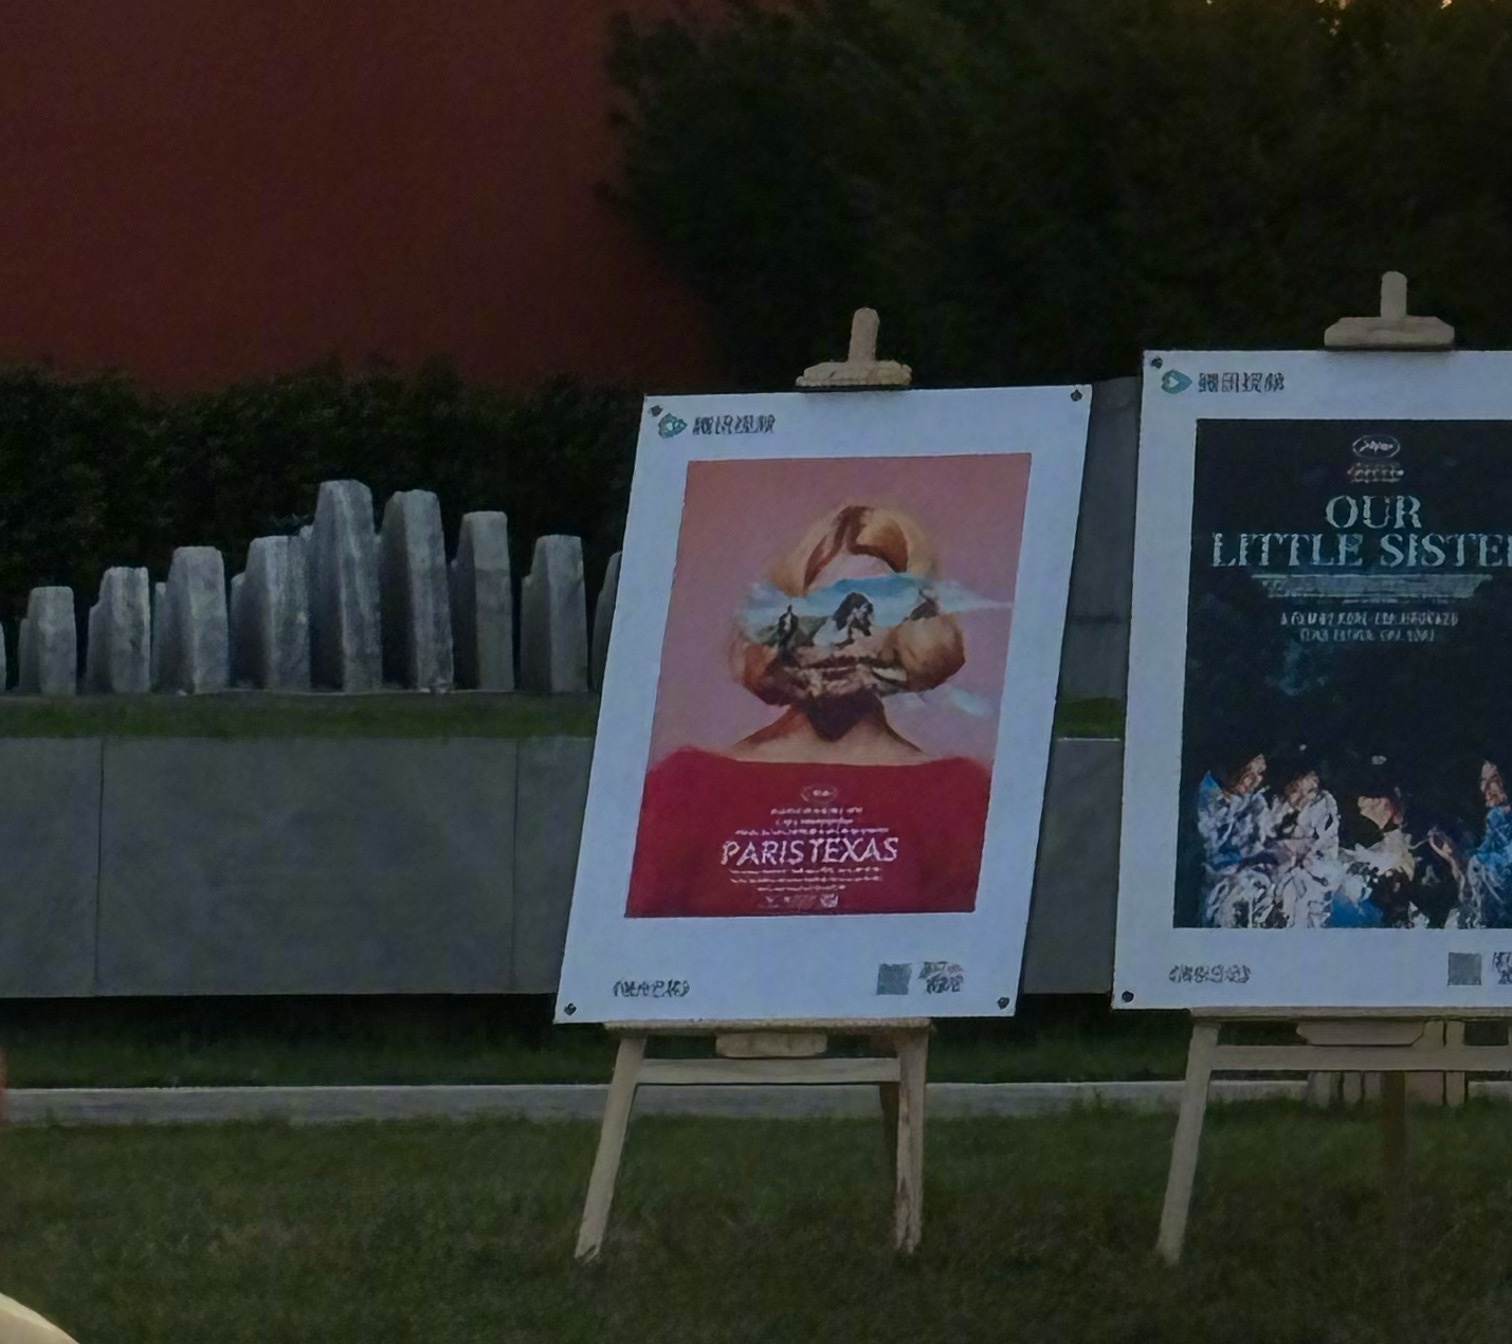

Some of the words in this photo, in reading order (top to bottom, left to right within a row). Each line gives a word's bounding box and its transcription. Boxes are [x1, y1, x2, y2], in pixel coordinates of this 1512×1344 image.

[1325, 495, 1423, 529] OUR
[1212, 532, 1364, 568] LITTLE
[719, 839, 805, 867] PARIS
[808, 836, 900, 864] TEXAS
